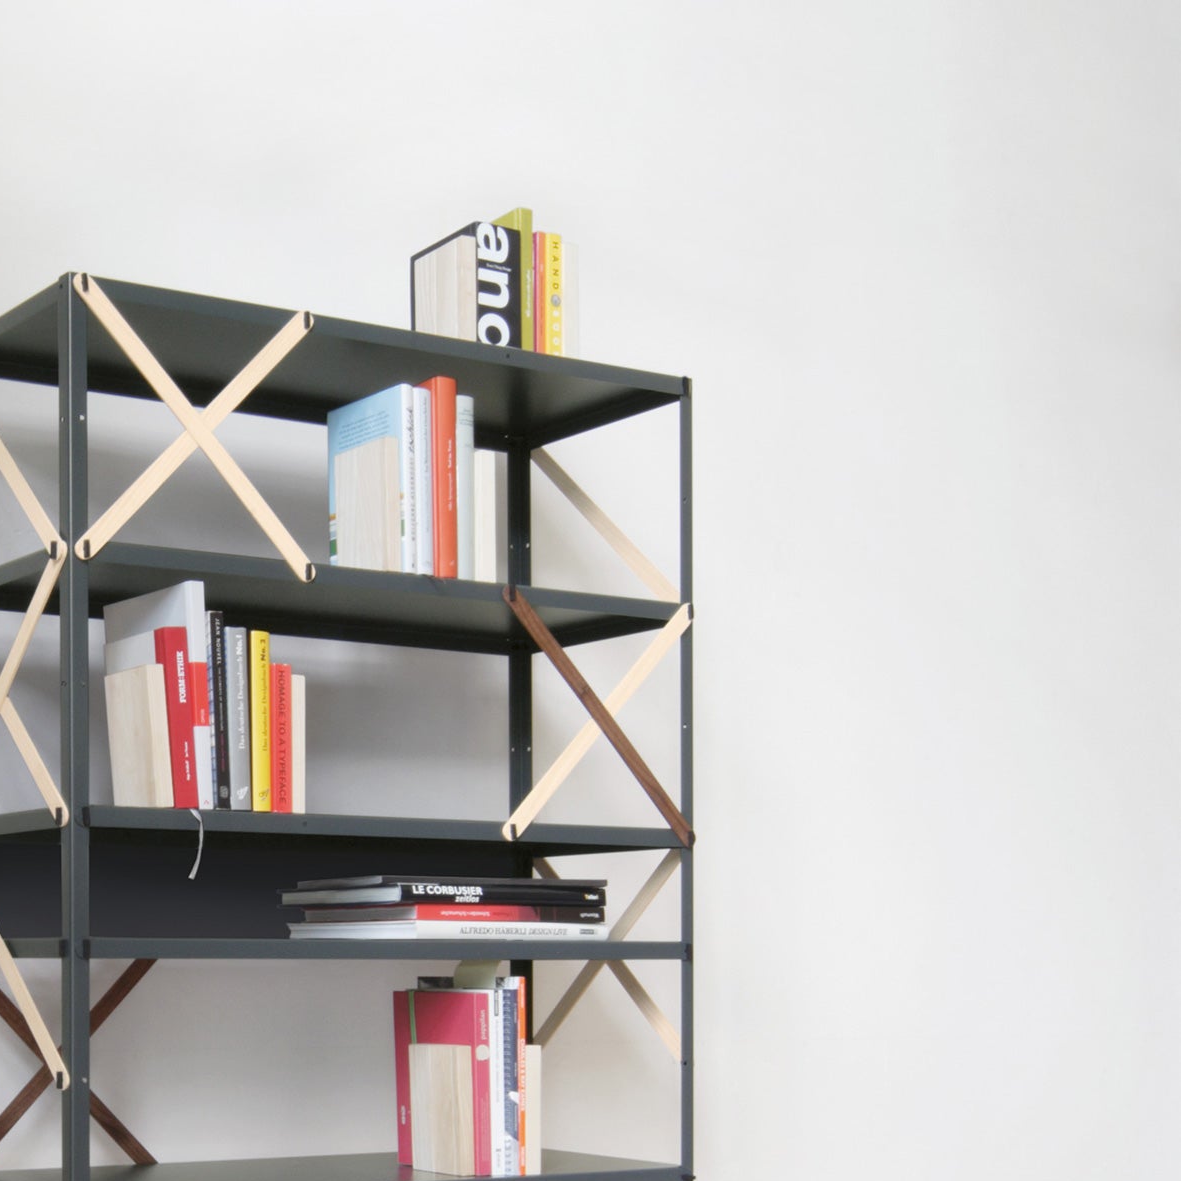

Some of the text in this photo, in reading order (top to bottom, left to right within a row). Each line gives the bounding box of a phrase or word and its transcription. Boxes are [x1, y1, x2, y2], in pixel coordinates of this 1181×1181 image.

[278, 721, 286, 736] TO
[278, 738, 286, 746] A
[278, 748, 287, 804] TYPEFACE
[412, 885, 484, 897] LE CORBUSIER
[459, 926, 495, 936] ALFREDO
